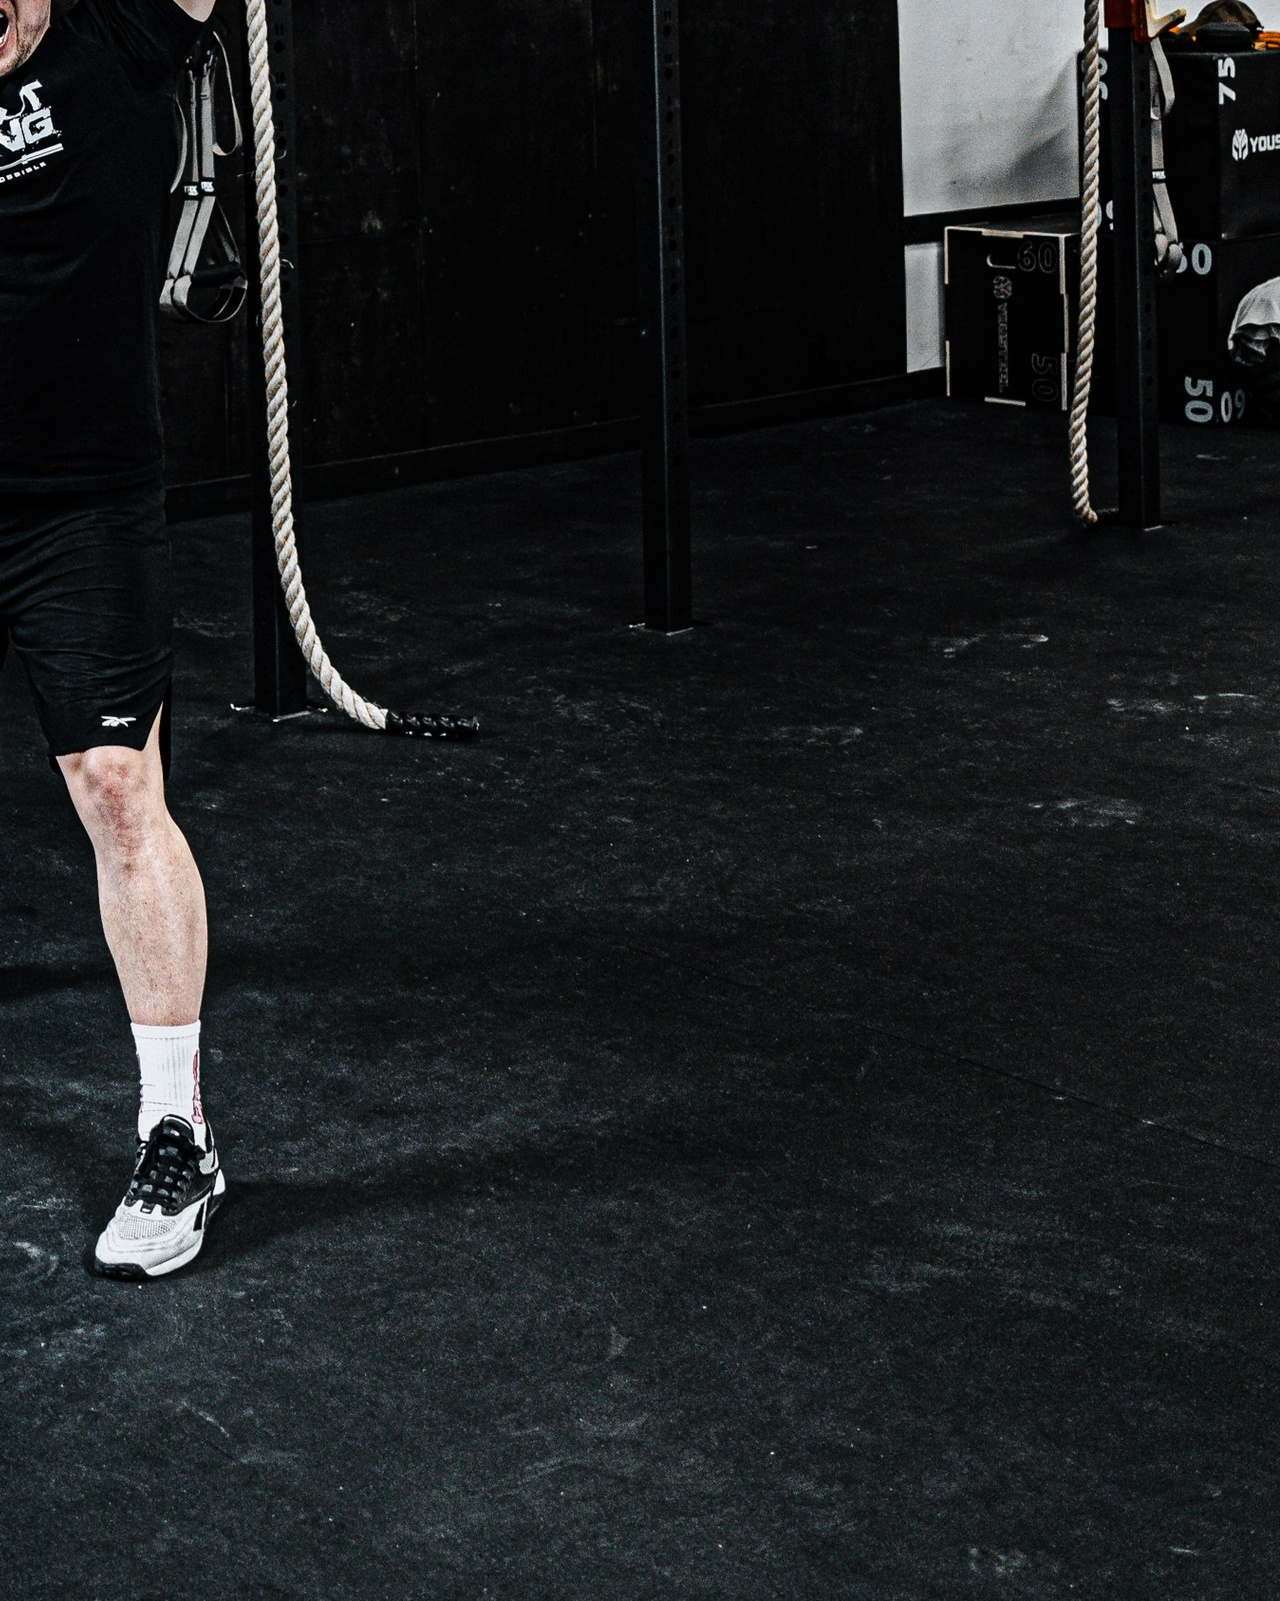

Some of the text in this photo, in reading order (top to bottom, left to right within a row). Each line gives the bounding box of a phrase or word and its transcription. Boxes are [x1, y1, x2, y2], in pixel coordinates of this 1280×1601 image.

[1218, 57, 1236, 105] 75
[1017, 241, 1058, 273] 60
[1031, 353, 1059, 402] 50
[1184, 375, 1214, 423] 50
